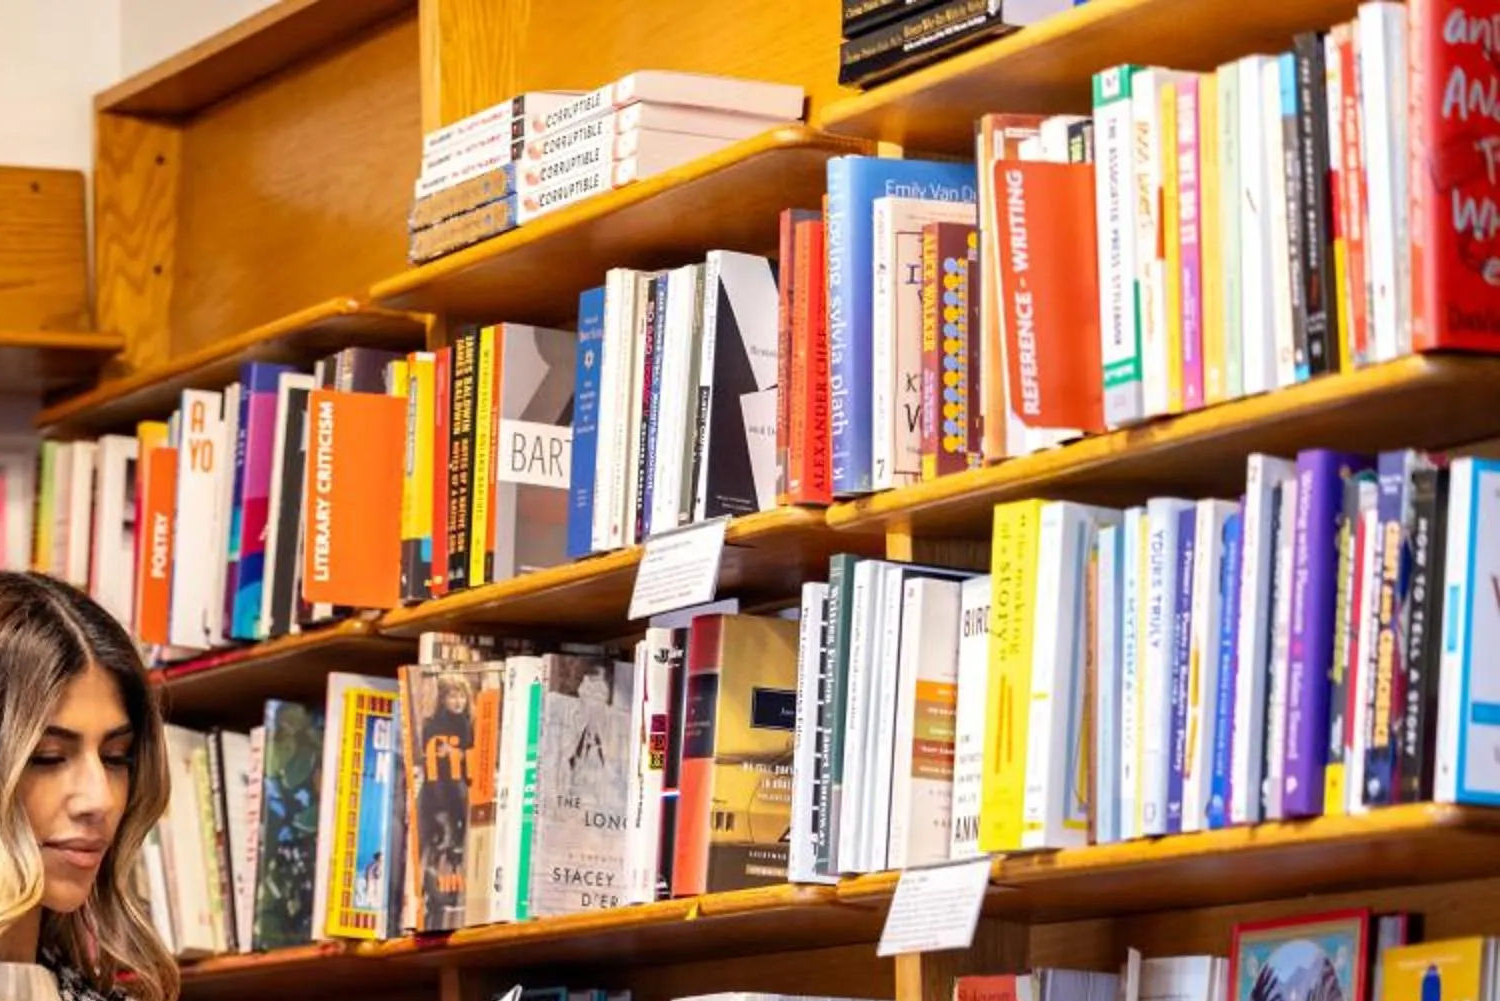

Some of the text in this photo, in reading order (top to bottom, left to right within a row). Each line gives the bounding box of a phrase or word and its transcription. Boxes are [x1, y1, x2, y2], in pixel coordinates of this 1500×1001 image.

[885, 179, 927, 199] Emily
[930, 184, 960, 201] Van
[1111, 229, 1120, 267] PRESS
[1004, 169, 1041, 415] REFERENCE WRITING
[829, 213, 849, 435] loving sylvia plath
[191, 400, 205, 433] A
[462, 376, 473, 434] BALDWIN
[190, 440, 213, 473] YO
[813, 377, 827, 490] ALEXANDER
[314, 401, 334, 582] LITERARY CRITICISM
[151, 512, 169, 579] POETRY
[1416, 517, 1428, 566] HOW
[996, 560, 1012, 642] story
[1008, 568, 1025, 655] making
[1414, 574, 1426, 602] TO
[1149, 595, 1163, 648] TRULY
[1410, 610, 1424, 661] TELL
[825, 649, 837, 704] Fiction
[1406, 690, 1420, 756] STORY
[557, 796, 581, 809] THE
[553, 867, 614, 888] STACEY
